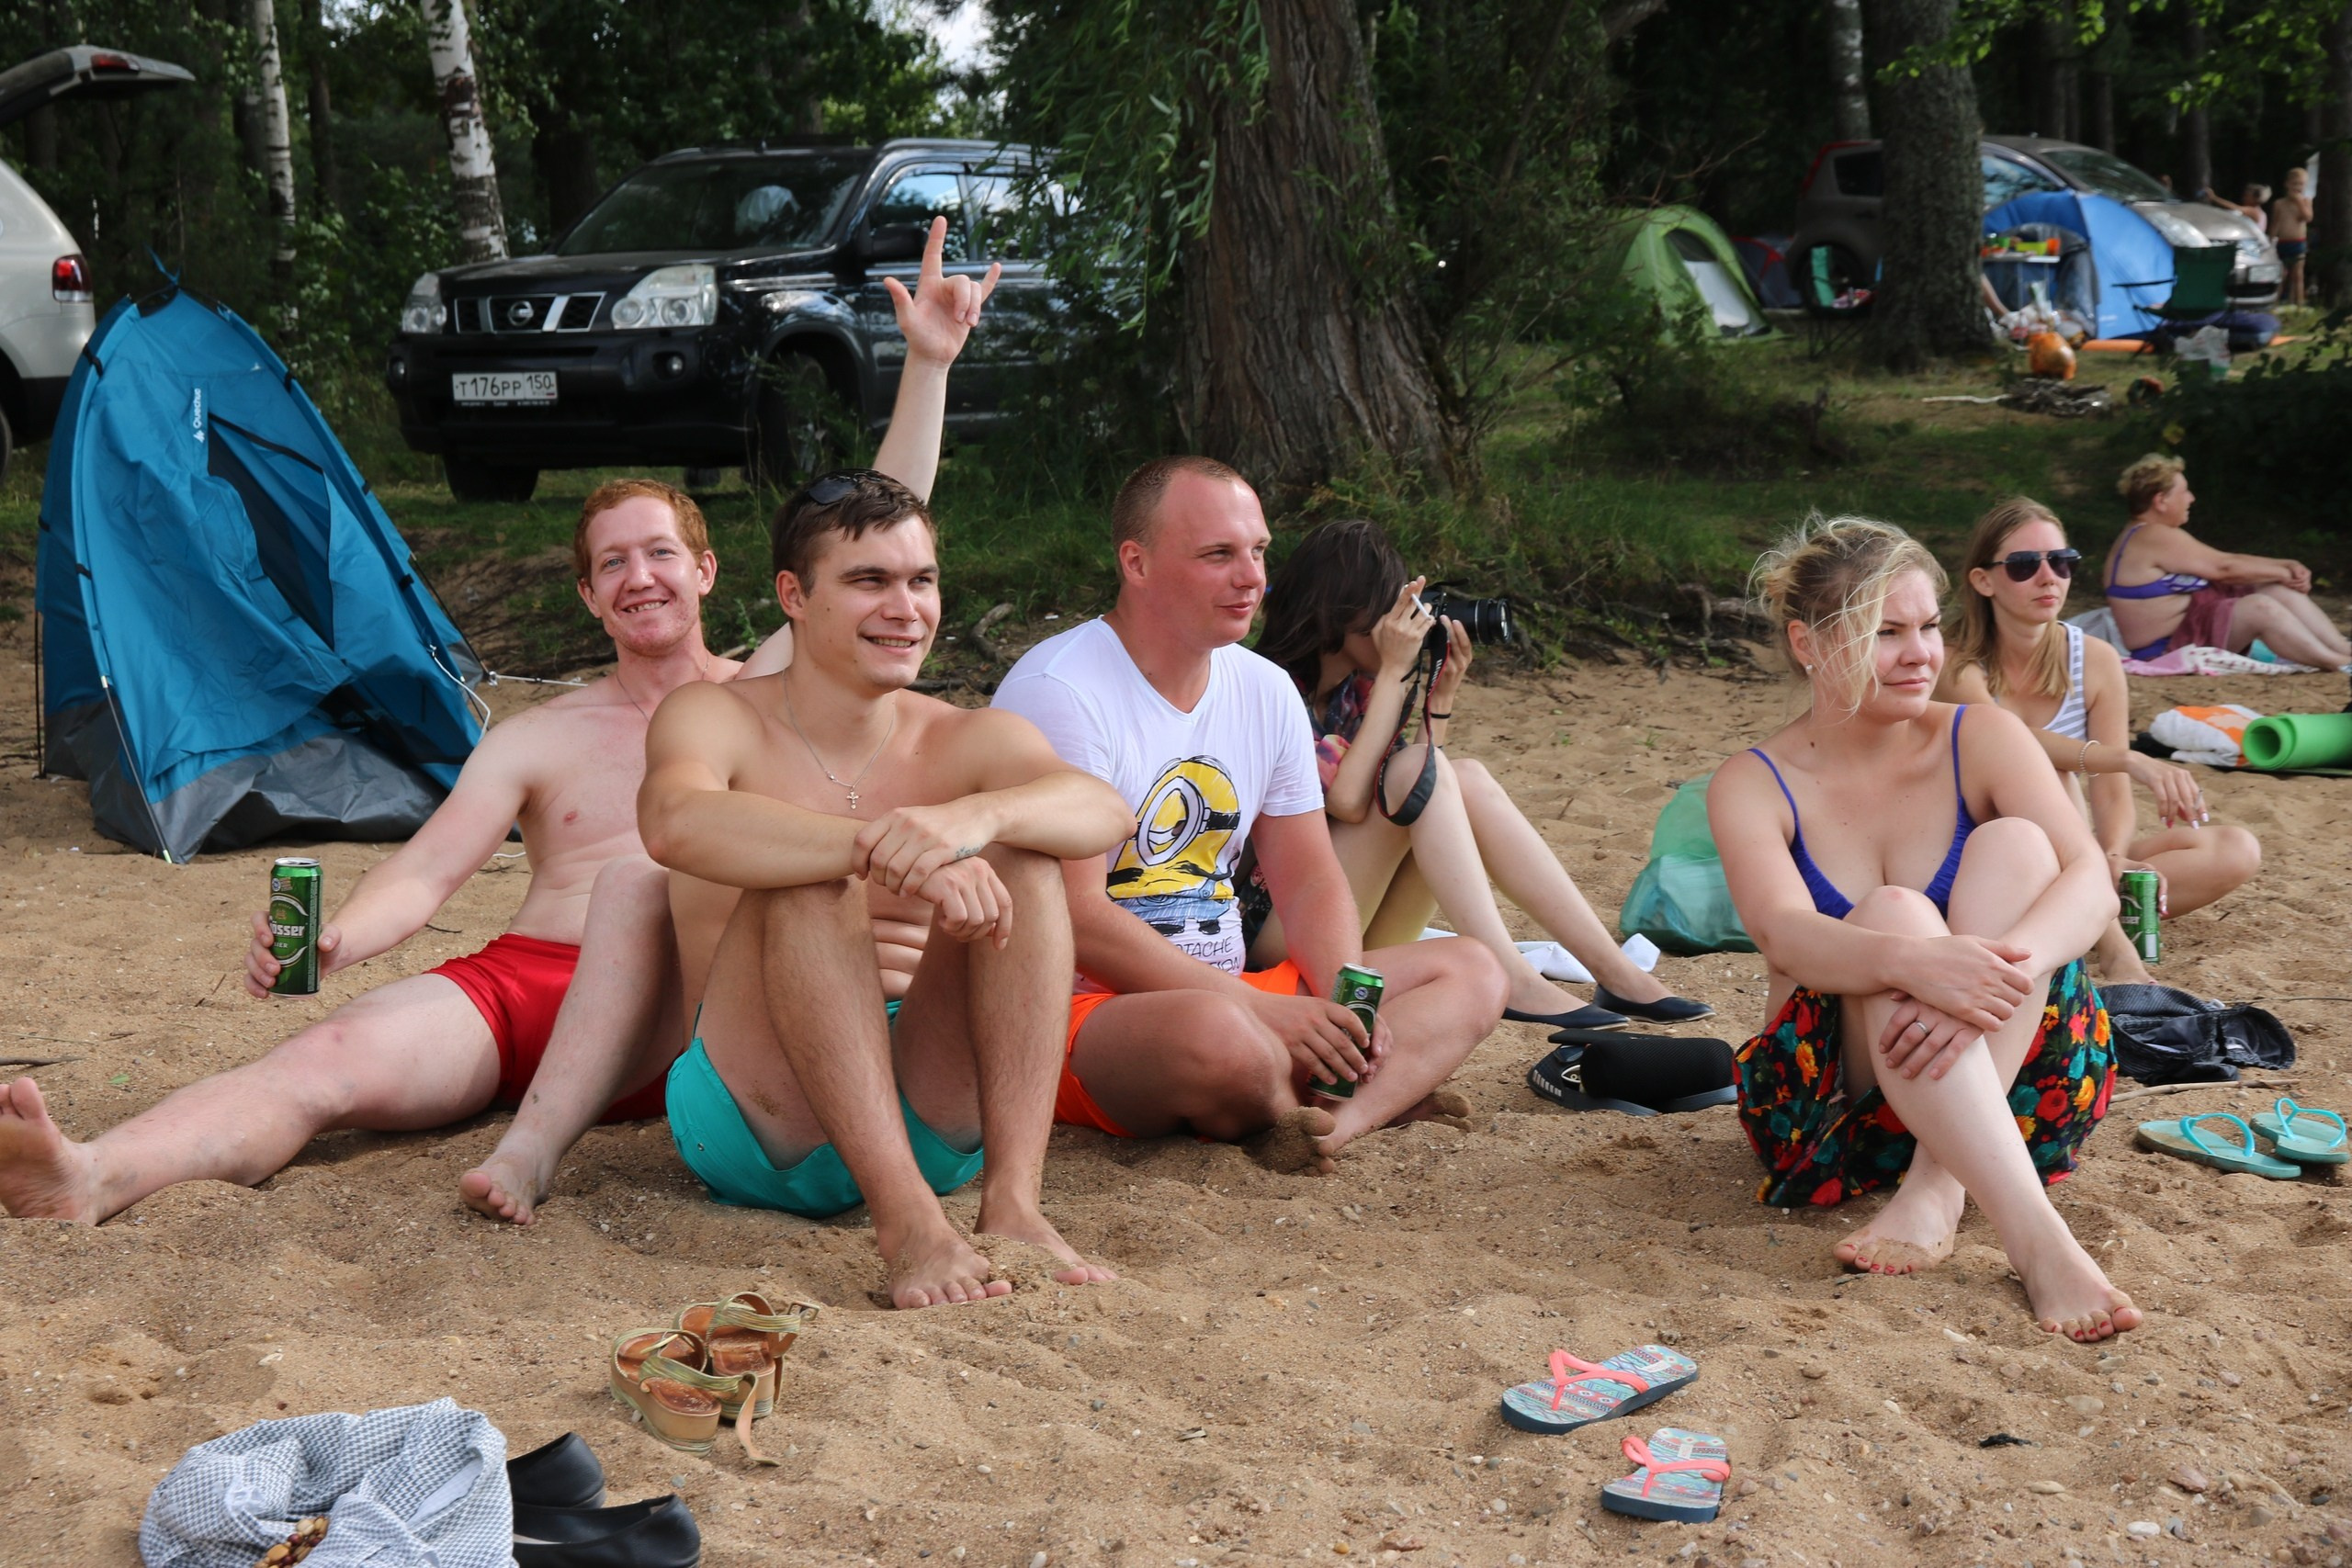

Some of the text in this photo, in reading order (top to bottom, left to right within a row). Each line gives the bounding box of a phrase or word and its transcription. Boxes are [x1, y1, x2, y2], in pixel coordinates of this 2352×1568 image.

[526, 374, 551, 390] 150
[193, 388, 202, 429] Quechua
[1174, 936, 1233, 957] TACHE
